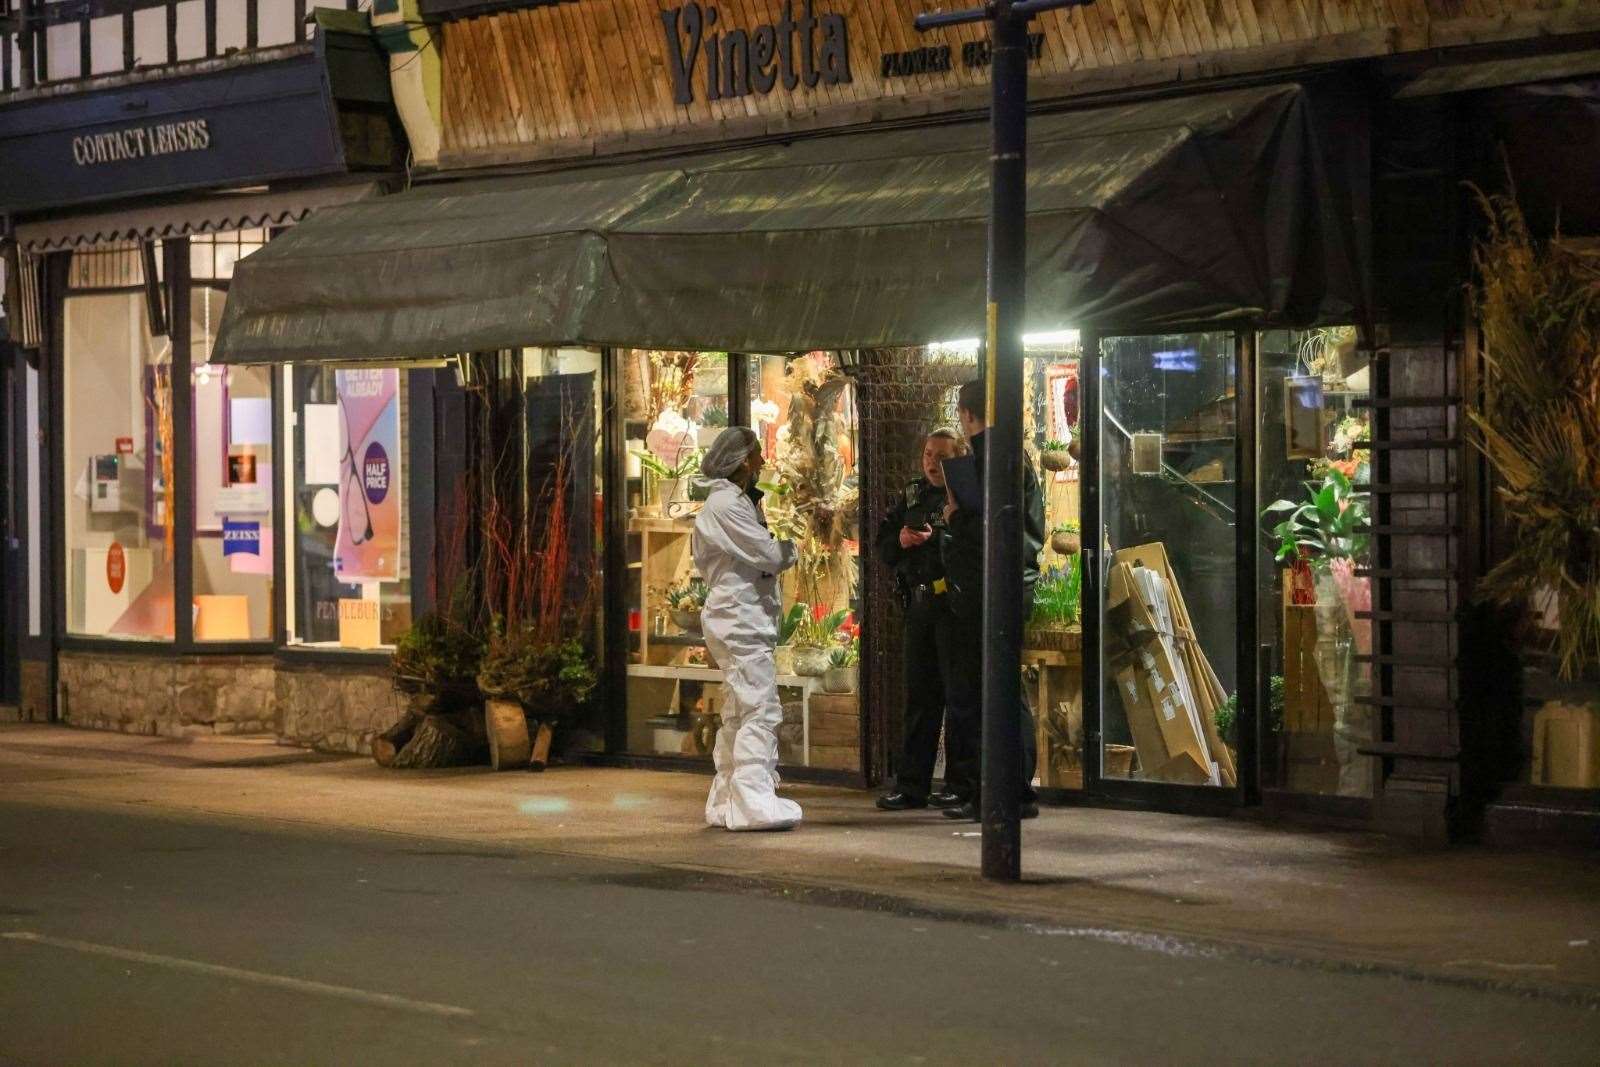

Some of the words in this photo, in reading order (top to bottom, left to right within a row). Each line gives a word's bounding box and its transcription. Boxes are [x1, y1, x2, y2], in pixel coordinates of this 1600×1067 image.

[661, 0, 852, 104] Vinetta
[73, 128, 145, 166] CONTACT
[149, 119, 209, 155] LENSES
[366, 463, 387, 476] HALF
[366, 477, 387, 489] PRICE
[224, 530, 259, 541] ZEISS
